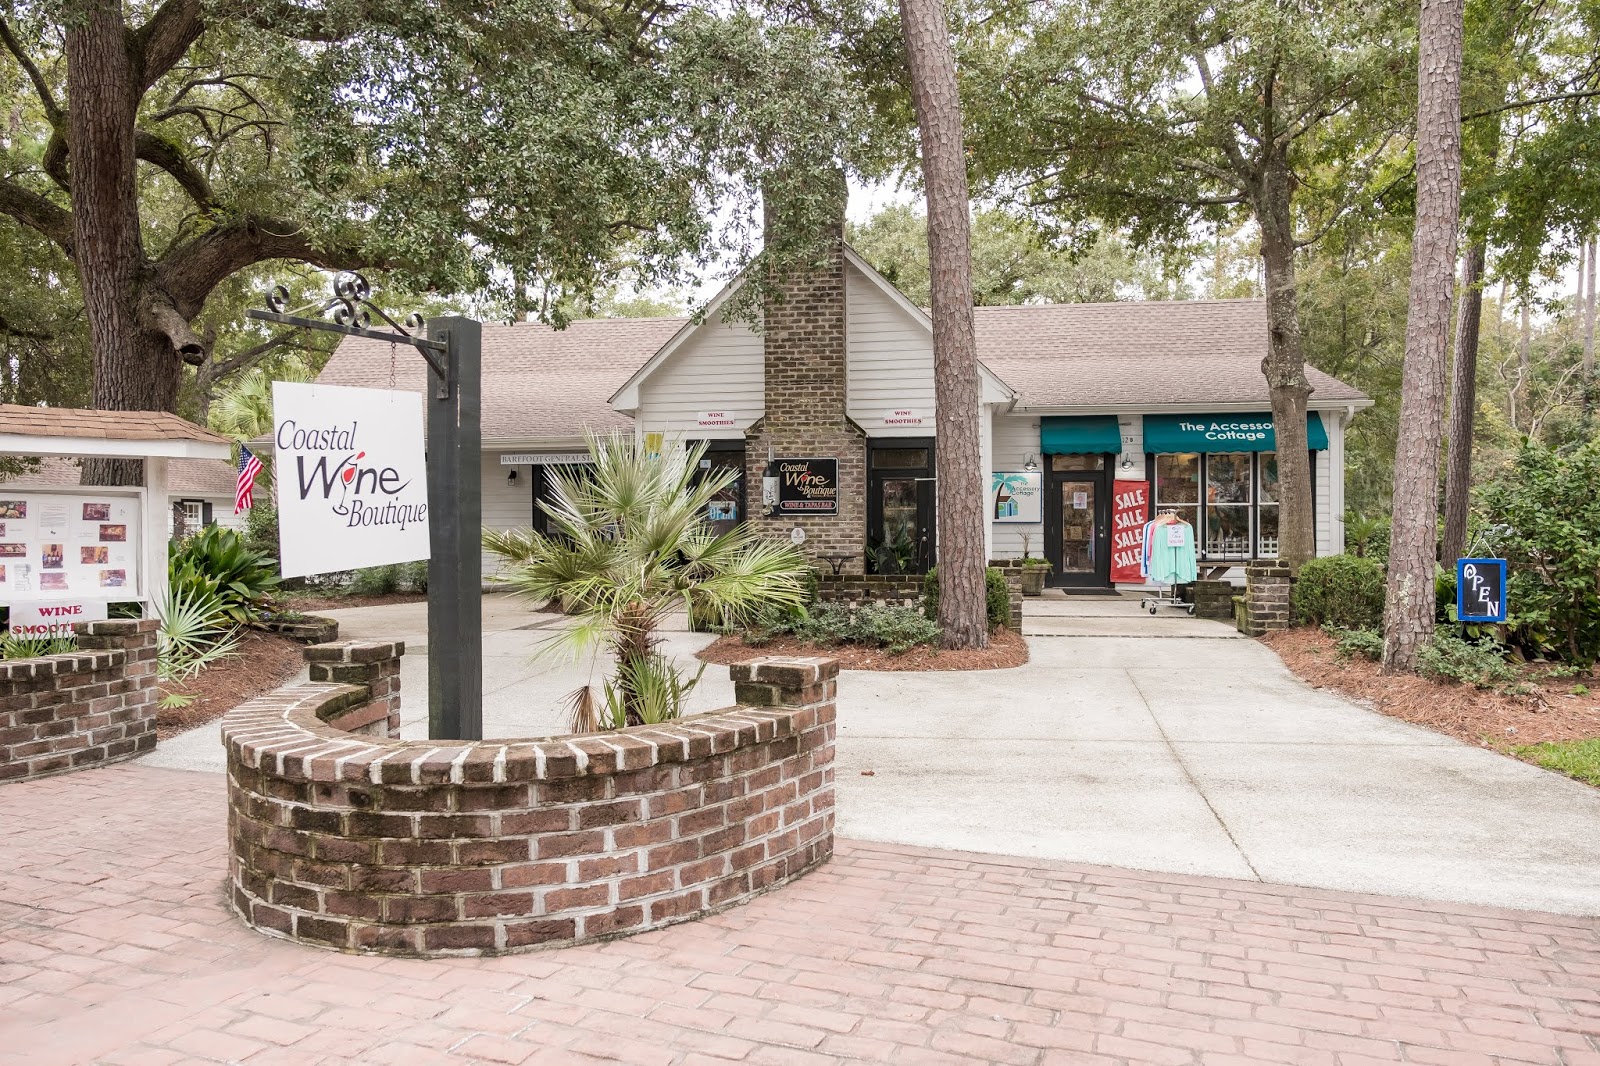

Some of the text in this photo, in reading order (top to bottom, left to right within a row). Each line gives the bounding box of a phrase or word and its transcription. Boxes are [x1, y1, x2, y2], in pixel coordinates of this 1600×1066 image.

[277, 420, 357, 450] Coastal
[1180, 422, 1205, 431] The
[1204, 431, 1266, 440] Cottage
[296, 454, 413, 501] Wine
[780, 462, 809, 472] Coastal
[802, 485, 836, 497] Boutique
[1115, 489, 1146, 510] SALE
[346, 497, 428, 531] Boutique
[1114, 509, 1144, 530] SALE
[1114, 528, 1143, 549] SALE
[1114, 548, 1142, 568] SALE
[1464, 564, 1500, 616] OPEN
[38, 605, 82, 617] WINE
